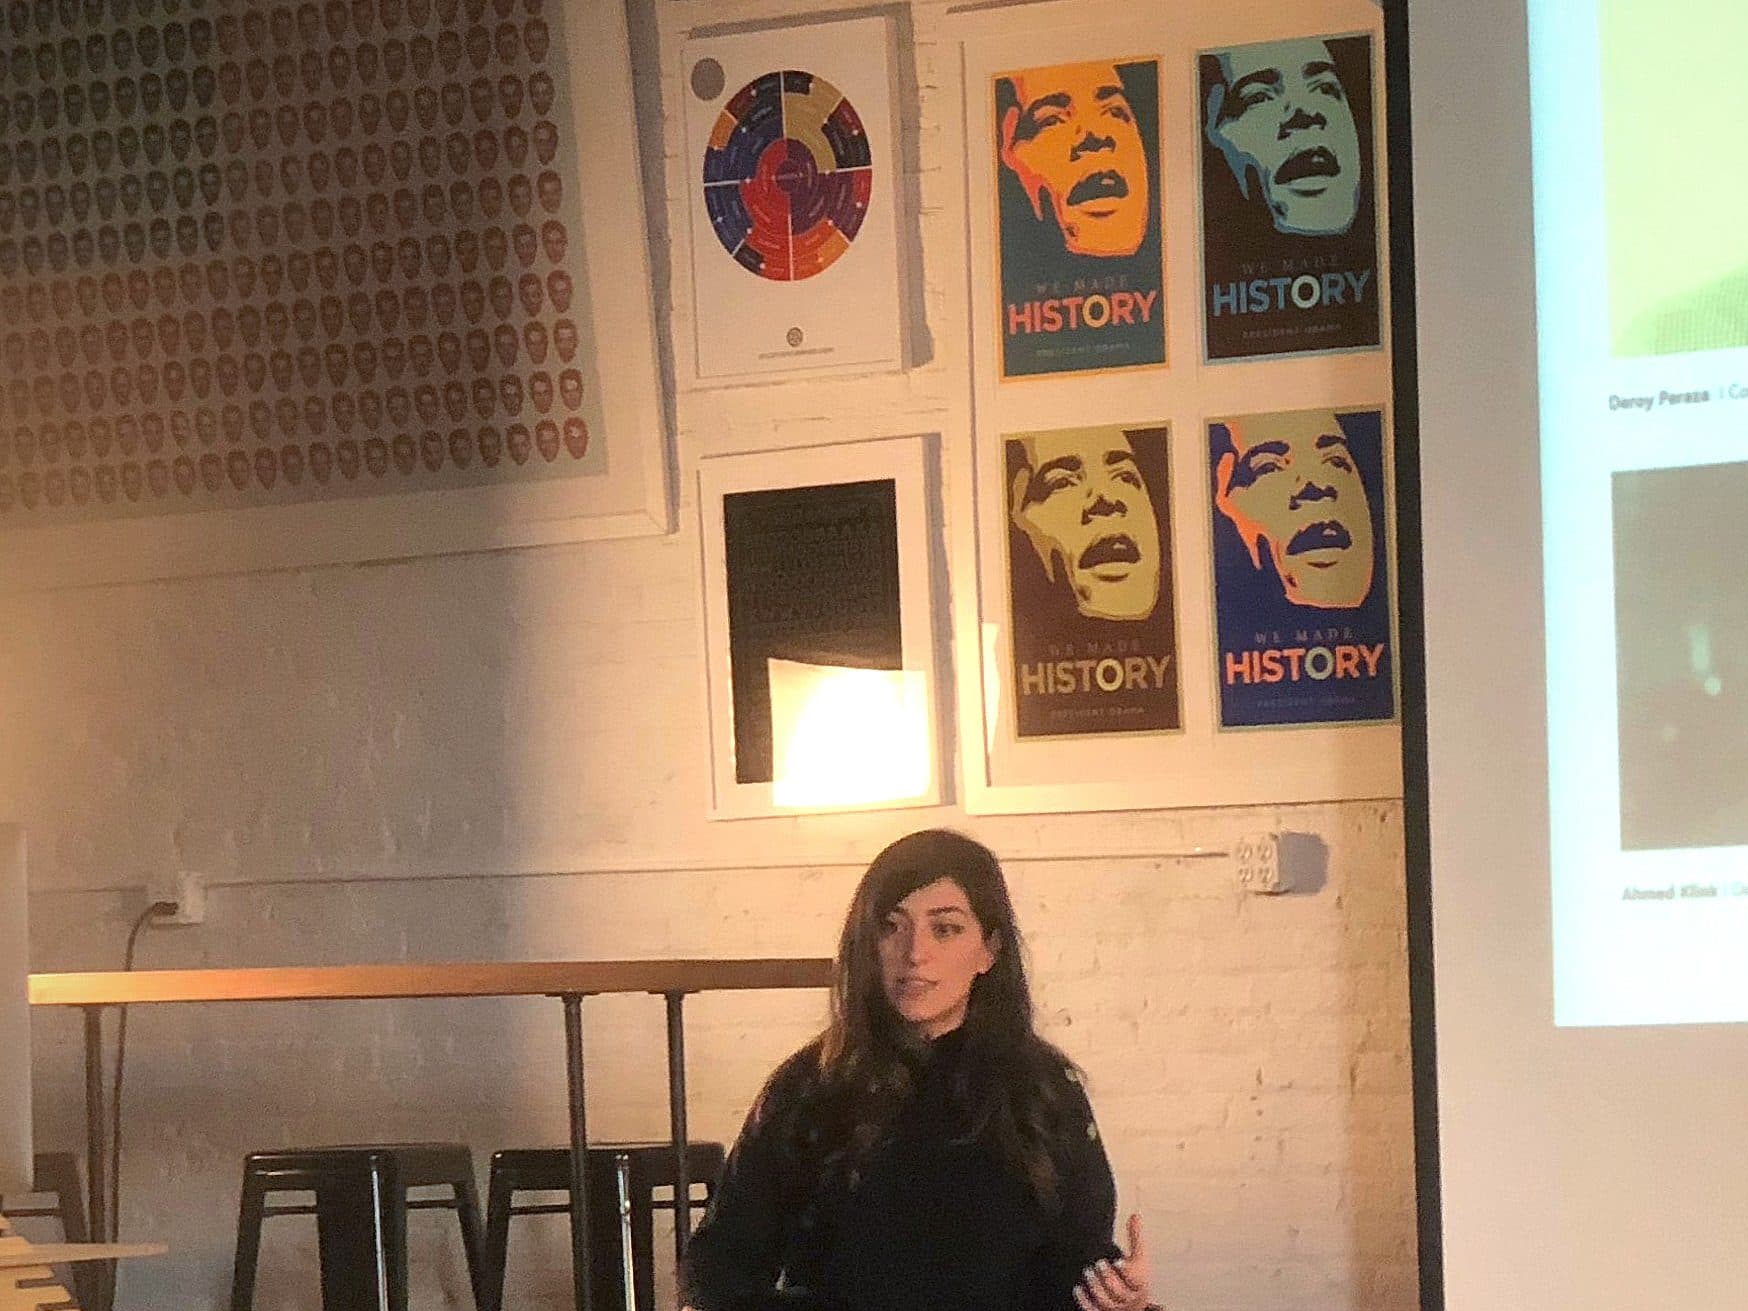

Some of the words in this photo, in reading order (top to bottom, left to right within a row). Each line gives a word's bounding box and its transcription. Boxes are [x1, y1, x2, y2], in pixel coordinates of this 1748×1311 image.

[1008, 289, 1157, 335] HISTORY
[1213, 269, 1371, 317] HISTORY
[1255, 631, 1281, 644] WE
[1295, 627, 1353, 641] MADE
[1021, 655, 1171, 696] HISTORY
[1226, 643, 1384, 684] HISTORY
